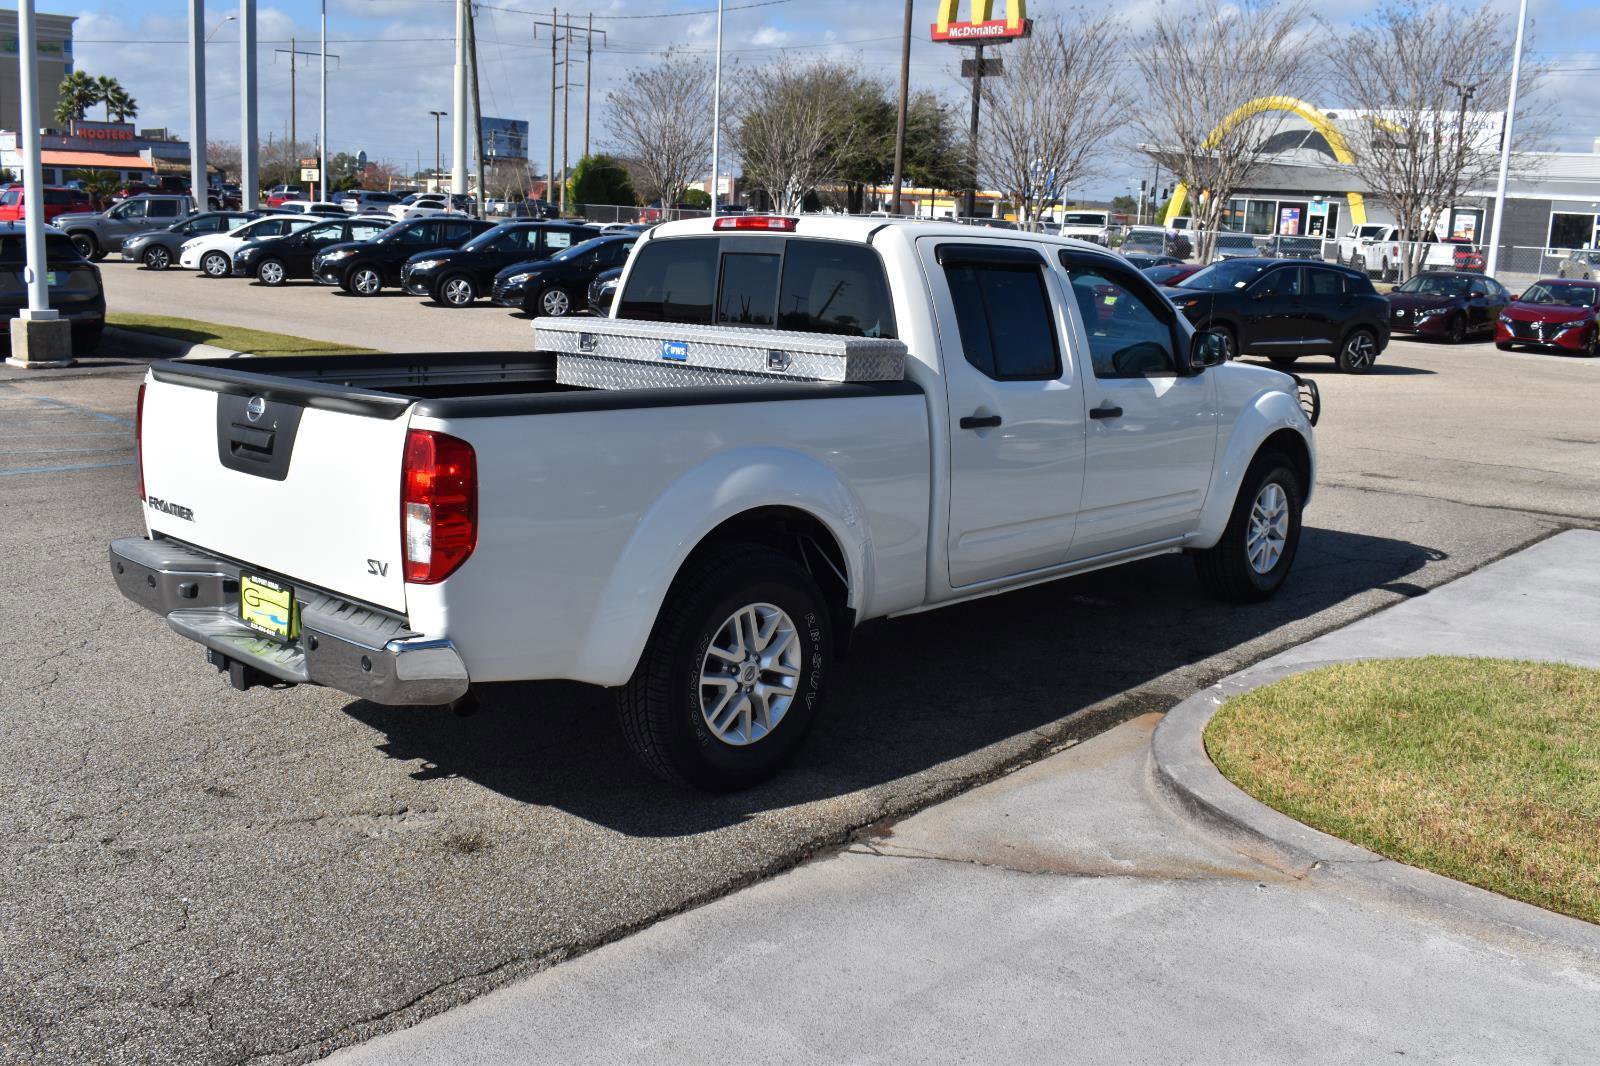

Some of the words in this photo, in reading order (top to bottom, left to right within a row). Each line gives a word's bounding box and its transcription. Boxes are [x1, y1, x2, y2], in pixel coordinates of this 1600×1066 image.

[949, 25, 1004, 37] McDonald's
[79, 128, 134, 139] HOOTERS
[149, 496, 194, 522] FRONTIER
[367, 559, 388, 577] SV
